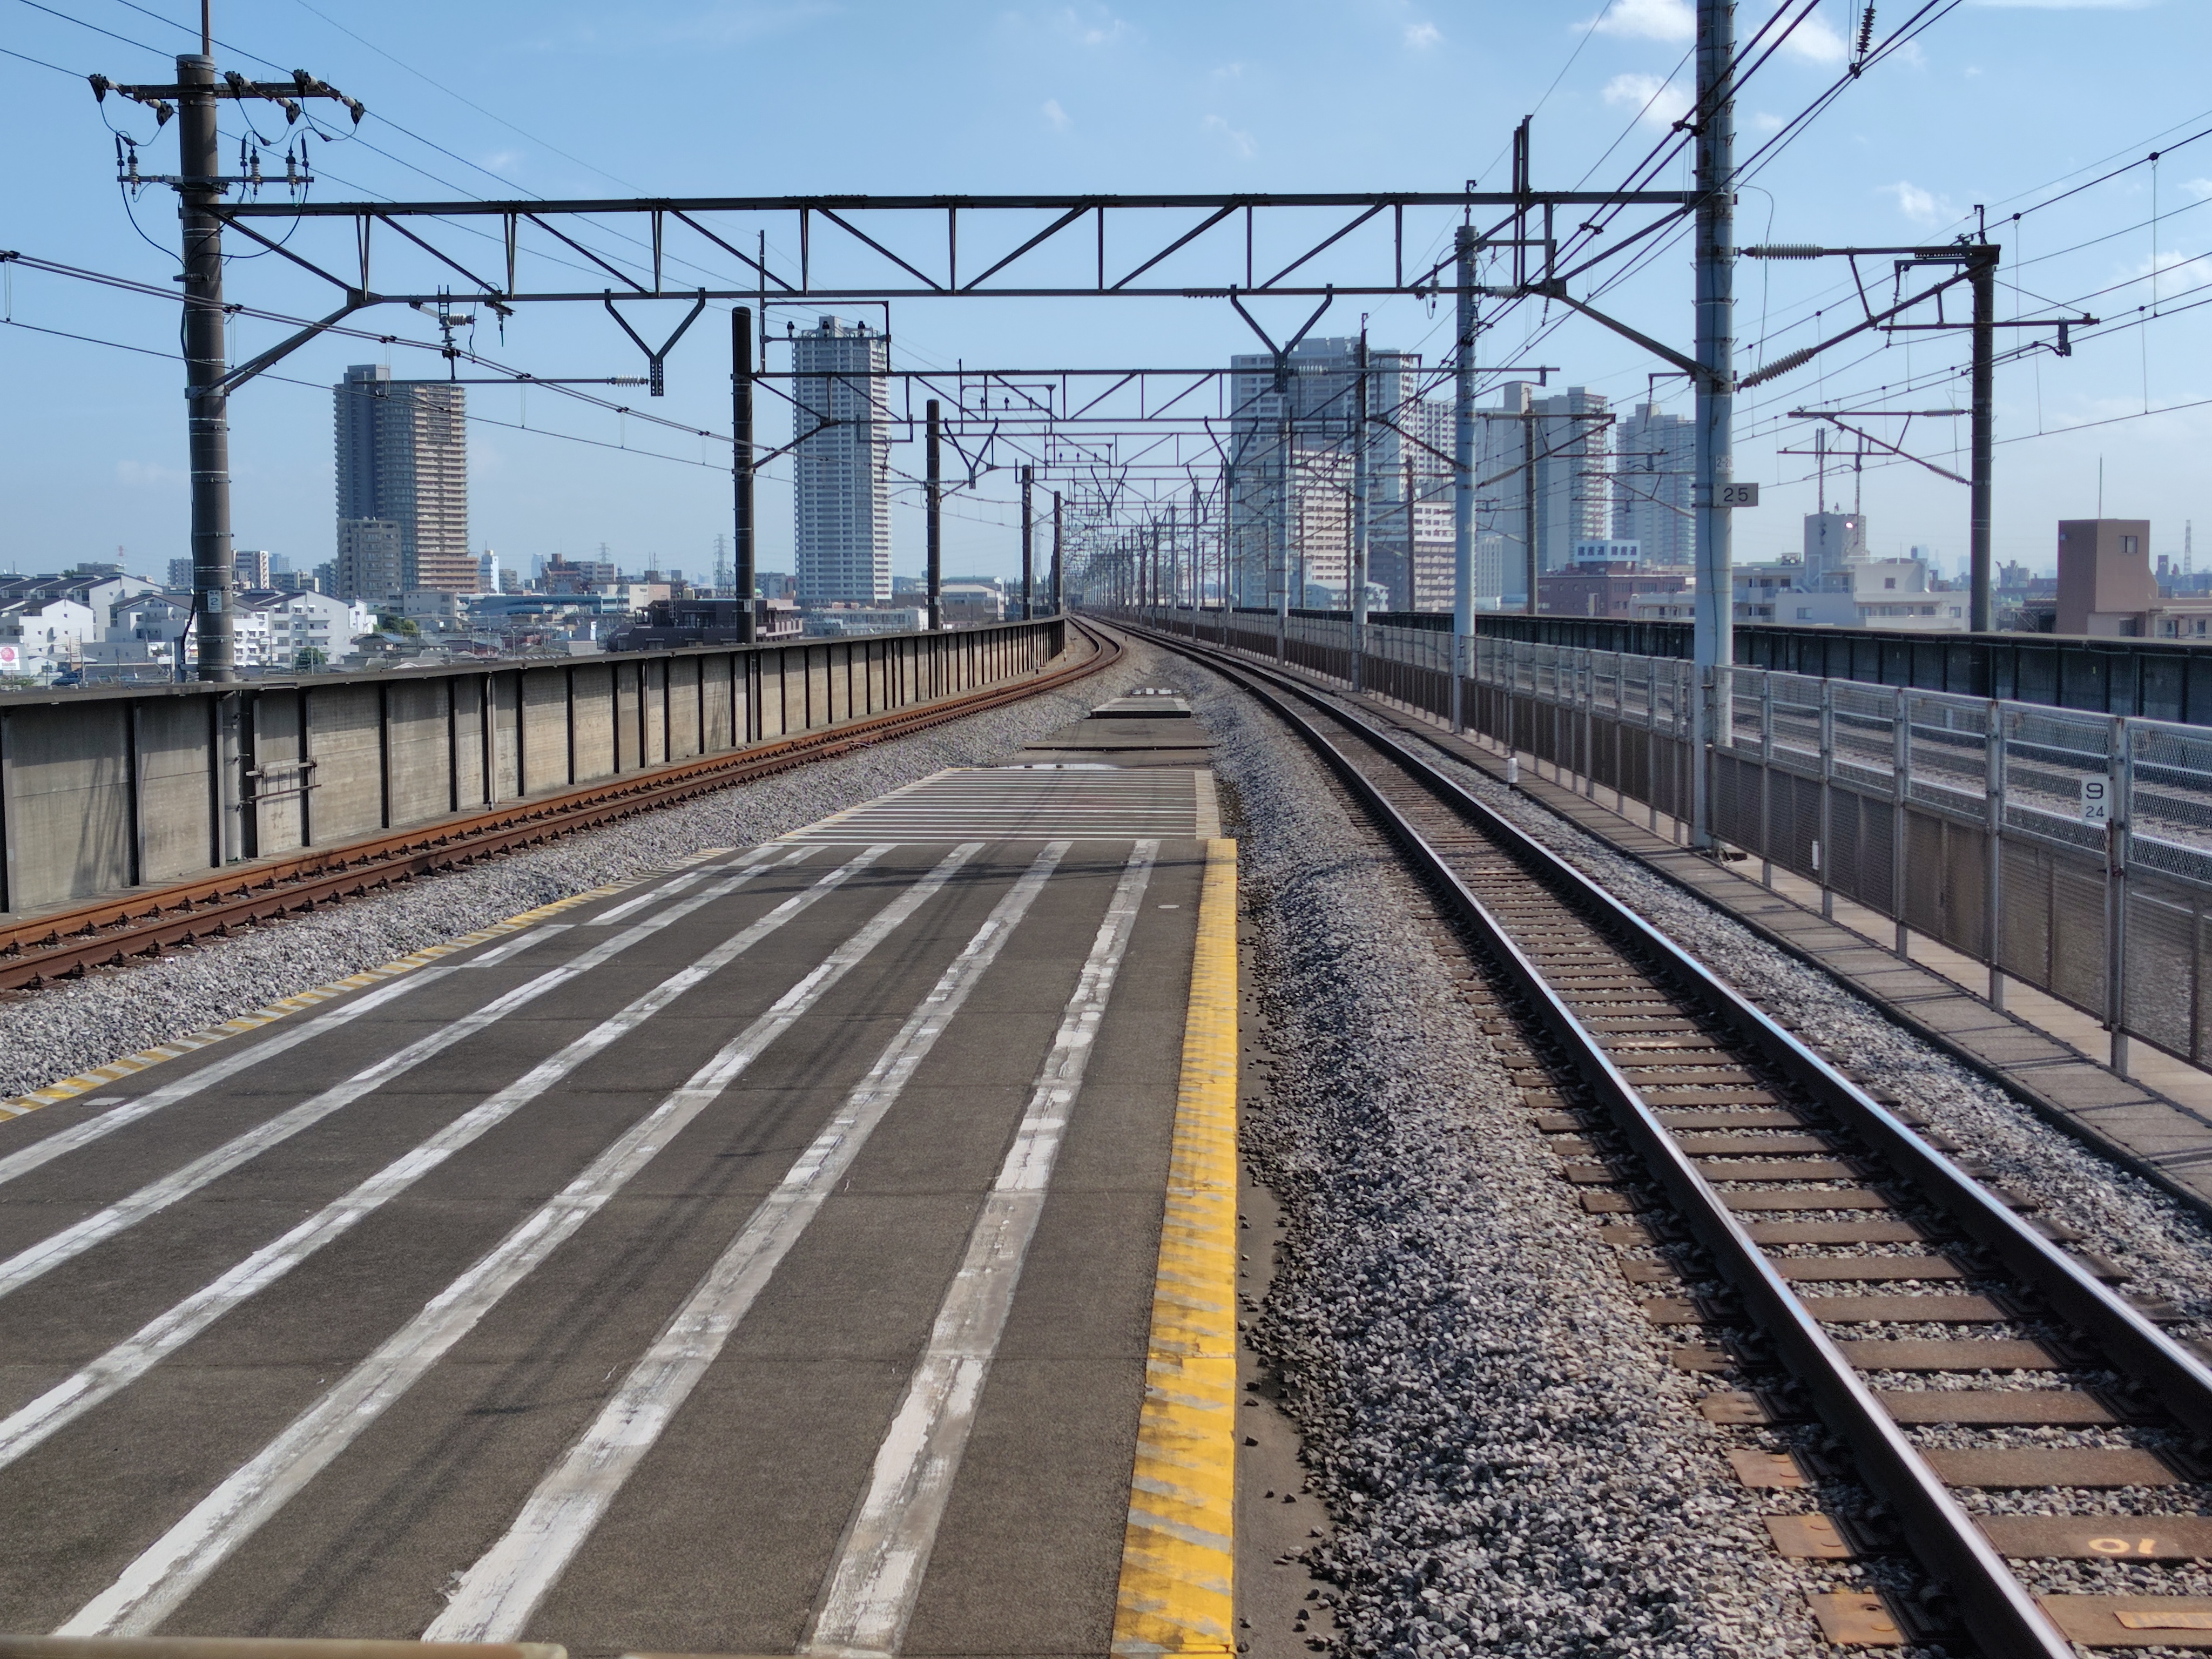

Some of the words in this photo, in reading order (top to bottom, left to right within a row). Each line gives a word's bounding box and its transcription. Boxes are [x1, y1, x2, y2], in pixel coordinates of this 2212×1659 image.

[1723, 487, 1748, 502] 25
[210, 597, 219, 605] 2
[2086, 783, 2103, 799] 9
[2085, 805, 2104, 818] 24
